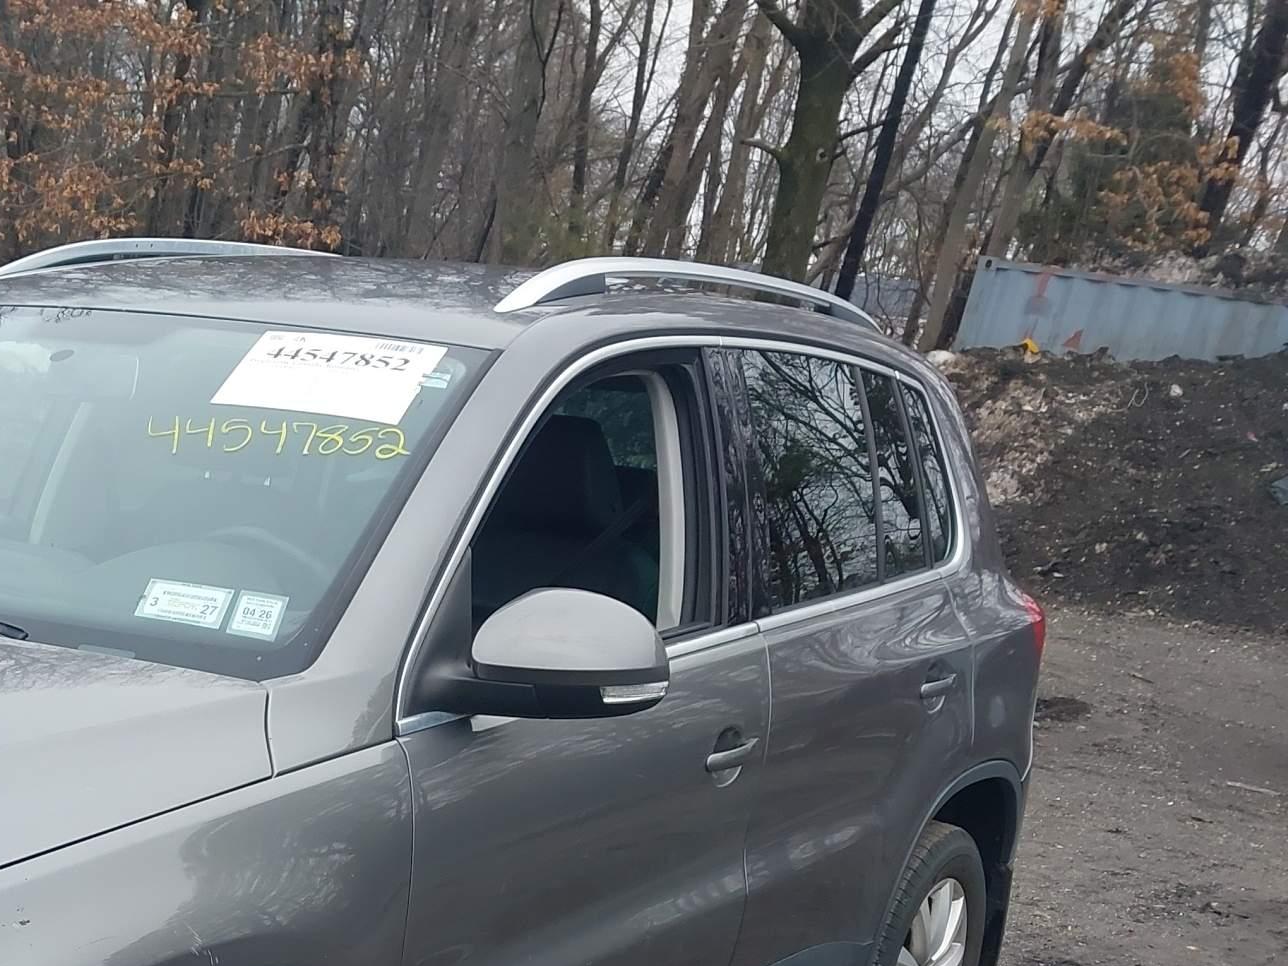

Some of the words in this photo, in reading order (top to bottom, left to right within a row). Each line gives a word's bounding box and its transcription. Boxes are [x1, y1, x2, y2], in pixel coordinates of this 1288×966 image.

[266, 346, 411, 372] 44547852
[147, 415, 411, 460] 44547852
[199, 604, 219, 616] 27
